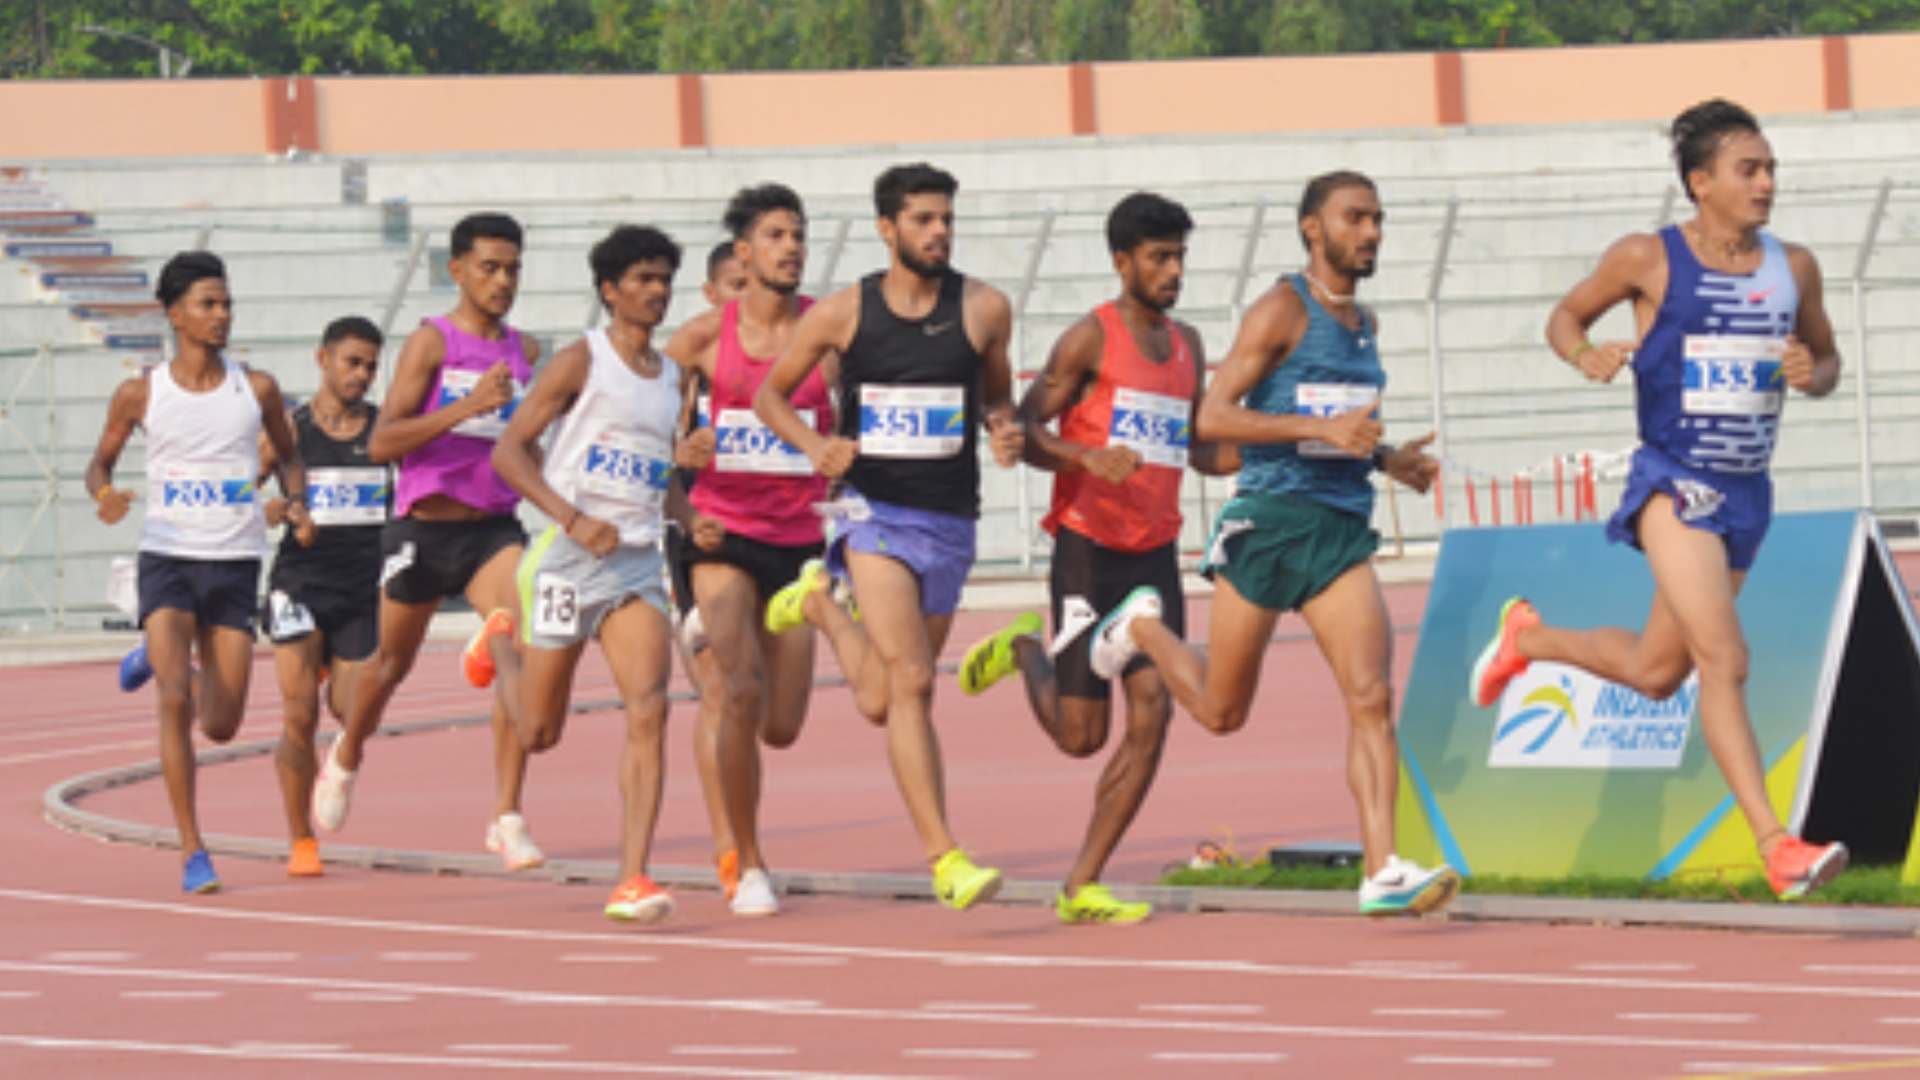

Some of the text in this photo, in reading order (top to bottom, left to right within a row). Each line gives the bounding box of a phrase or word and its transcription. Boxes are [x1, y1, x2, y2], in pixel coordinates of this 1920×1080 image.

[1699, 359, 1758, 391] 133
[876, 406, 924, 437] 351
[1114, 411, 1168, 446] 435
[590, 448, 653, 482] 283
[167, 480, 223, 506] 203
[1580, 723, 1688, 750] ATHLETICS
